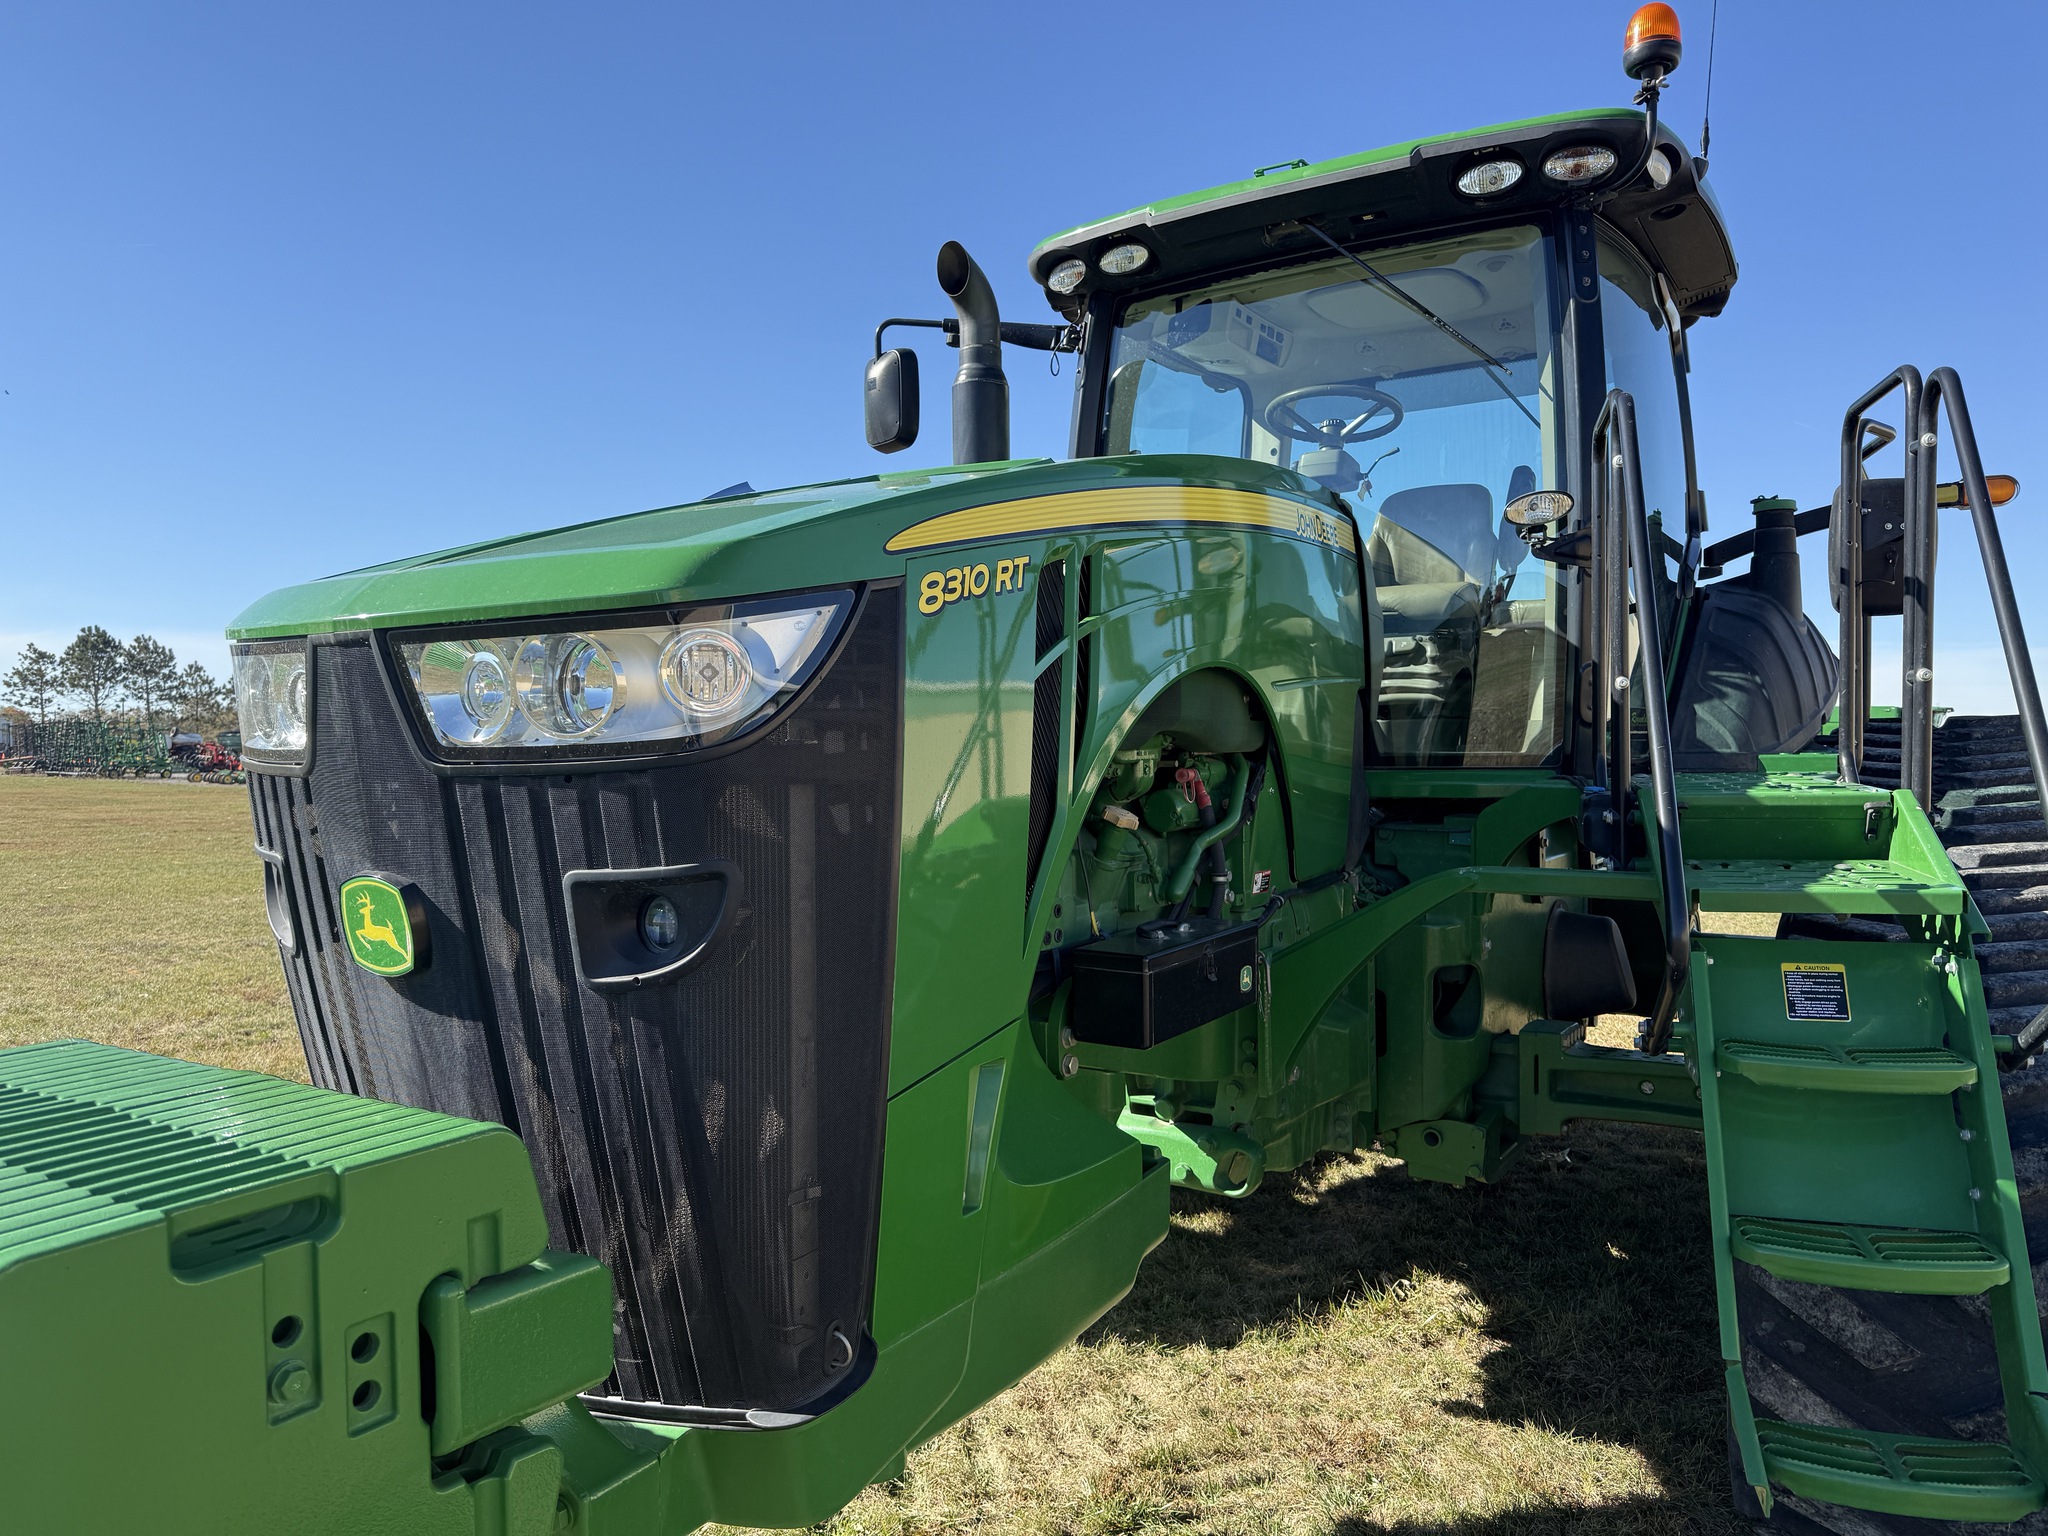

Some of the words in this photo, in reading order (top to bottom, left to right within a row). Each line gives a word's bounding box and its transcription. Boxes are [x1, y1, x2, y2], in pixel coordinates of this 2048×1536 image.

[1296, 508, 1316, 539] JOHN
[1315, 514, 1339, 547] DEERE
[918, 563, 990, 617] 8310
[995, 555, 1030, 596] RT
